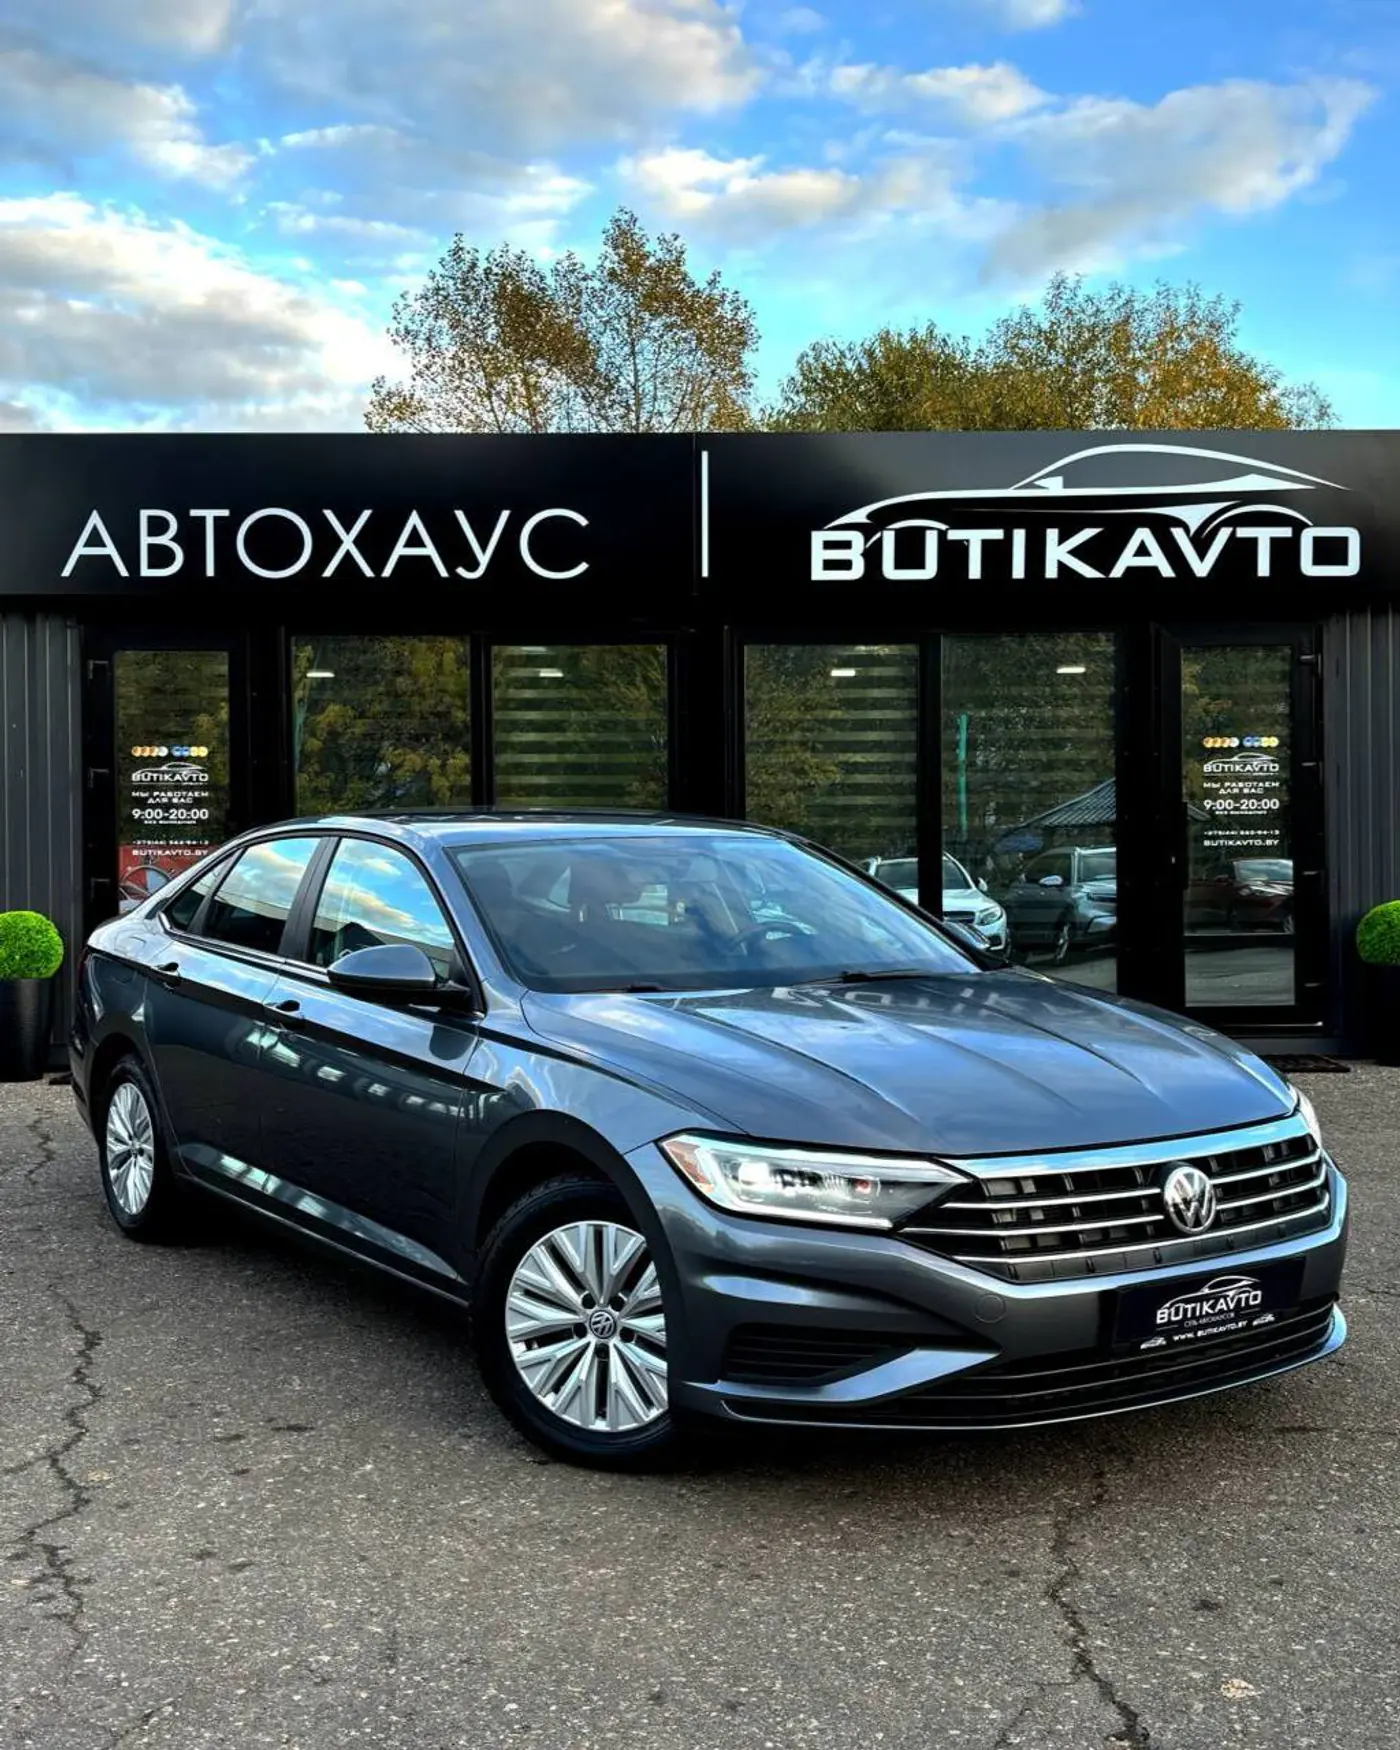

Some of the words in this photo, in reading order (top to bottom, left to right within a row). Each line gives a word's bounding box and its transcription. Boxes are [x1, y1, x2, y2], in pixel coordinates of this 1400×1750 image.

[61, 507, 590, 580] АВТОХАУС
[810, 526, 1361, 581] BUTIKAVTO
[1203, 764, 1279, 772] BUTIKAVTO
[132, 773, 208, 781] BUTIKAVTO
[1203, 799, 1280, 810] 9:00-20:00
[132, 809, 209, 819] 9:00-20:00
[1156, 1290, 1263, 1325] BUTIKAVTO
